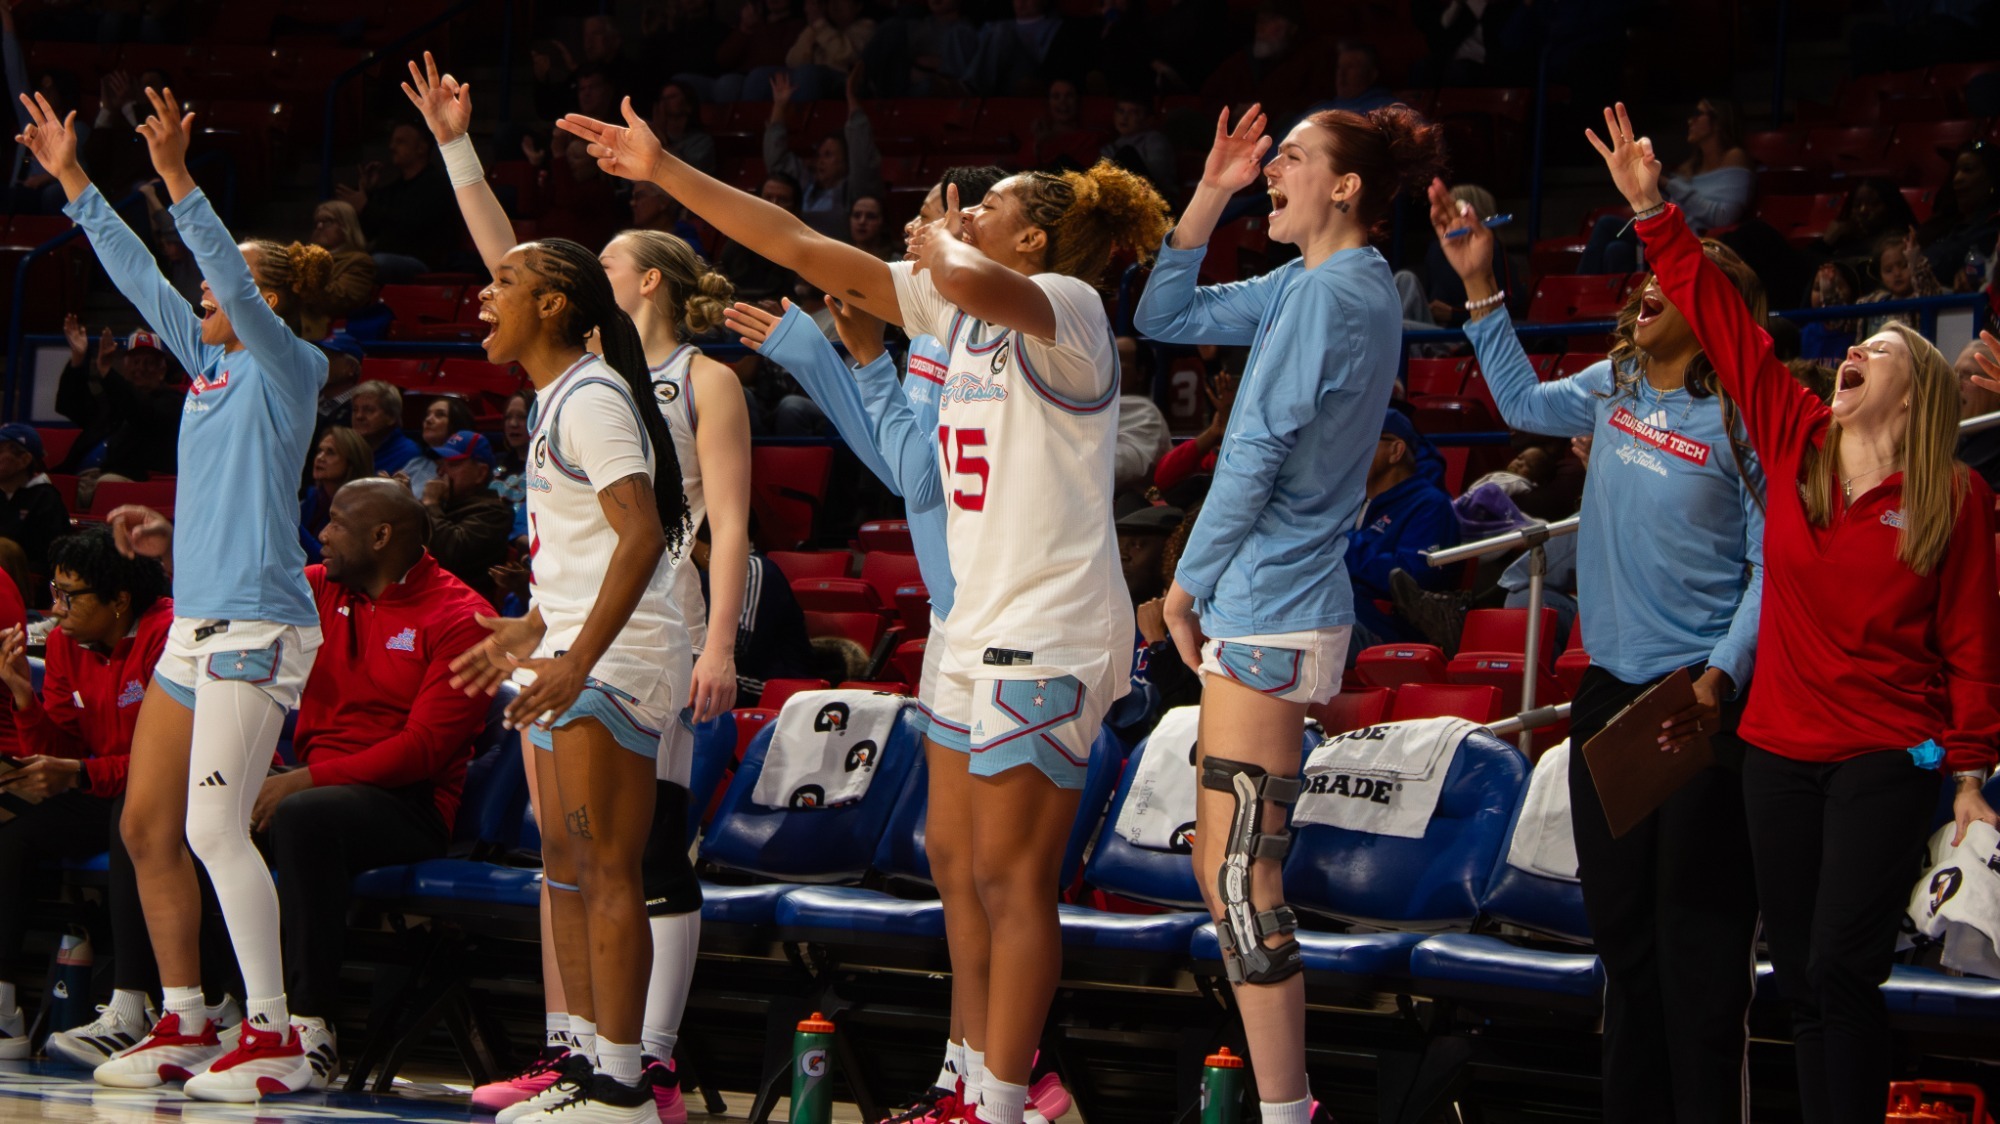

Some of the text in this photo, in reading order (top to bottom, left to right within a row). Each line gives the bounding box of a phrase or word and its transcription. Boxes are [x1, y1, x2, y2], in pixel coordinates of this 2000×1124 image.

[1171, 370, 1199, 417] 3
[1613, 410, 1706, 460] LOUISIANA TECH
[802, 1049, 826, 1077] G
